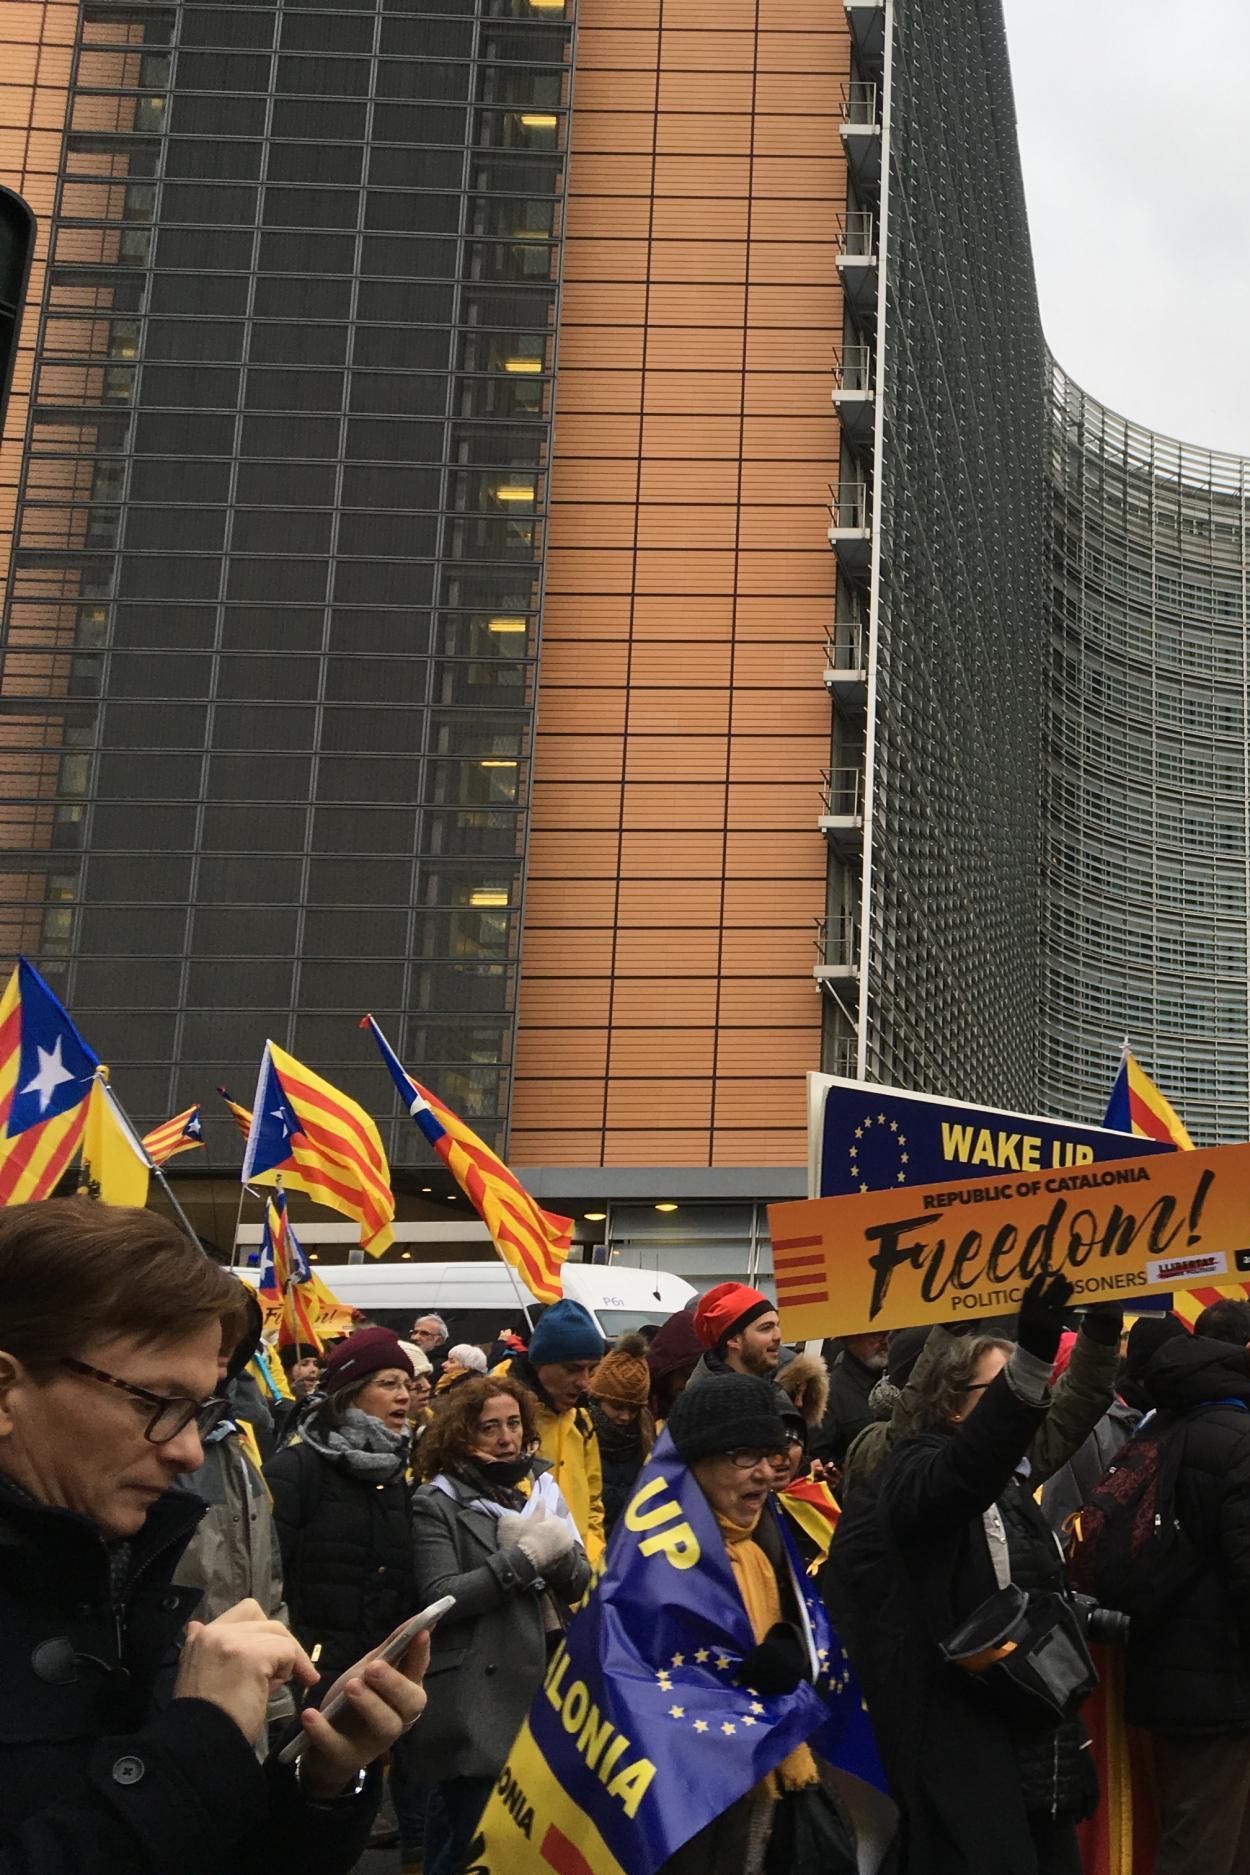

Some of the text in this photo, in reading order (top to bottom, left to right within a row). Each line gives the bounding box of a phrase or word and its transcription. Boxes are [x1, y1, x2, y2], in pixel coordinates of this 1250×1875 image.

[941, 1122, 1095, 1172] WAKE UP
[923, 1167, 1151, 1209] REPUBLIC OF CATALONIA
[865, 1169, 1215, 1322] Freedom!
[952, 1288, 1023, 1310] POLITIC
[624, 1476, 701, 1570] UP
